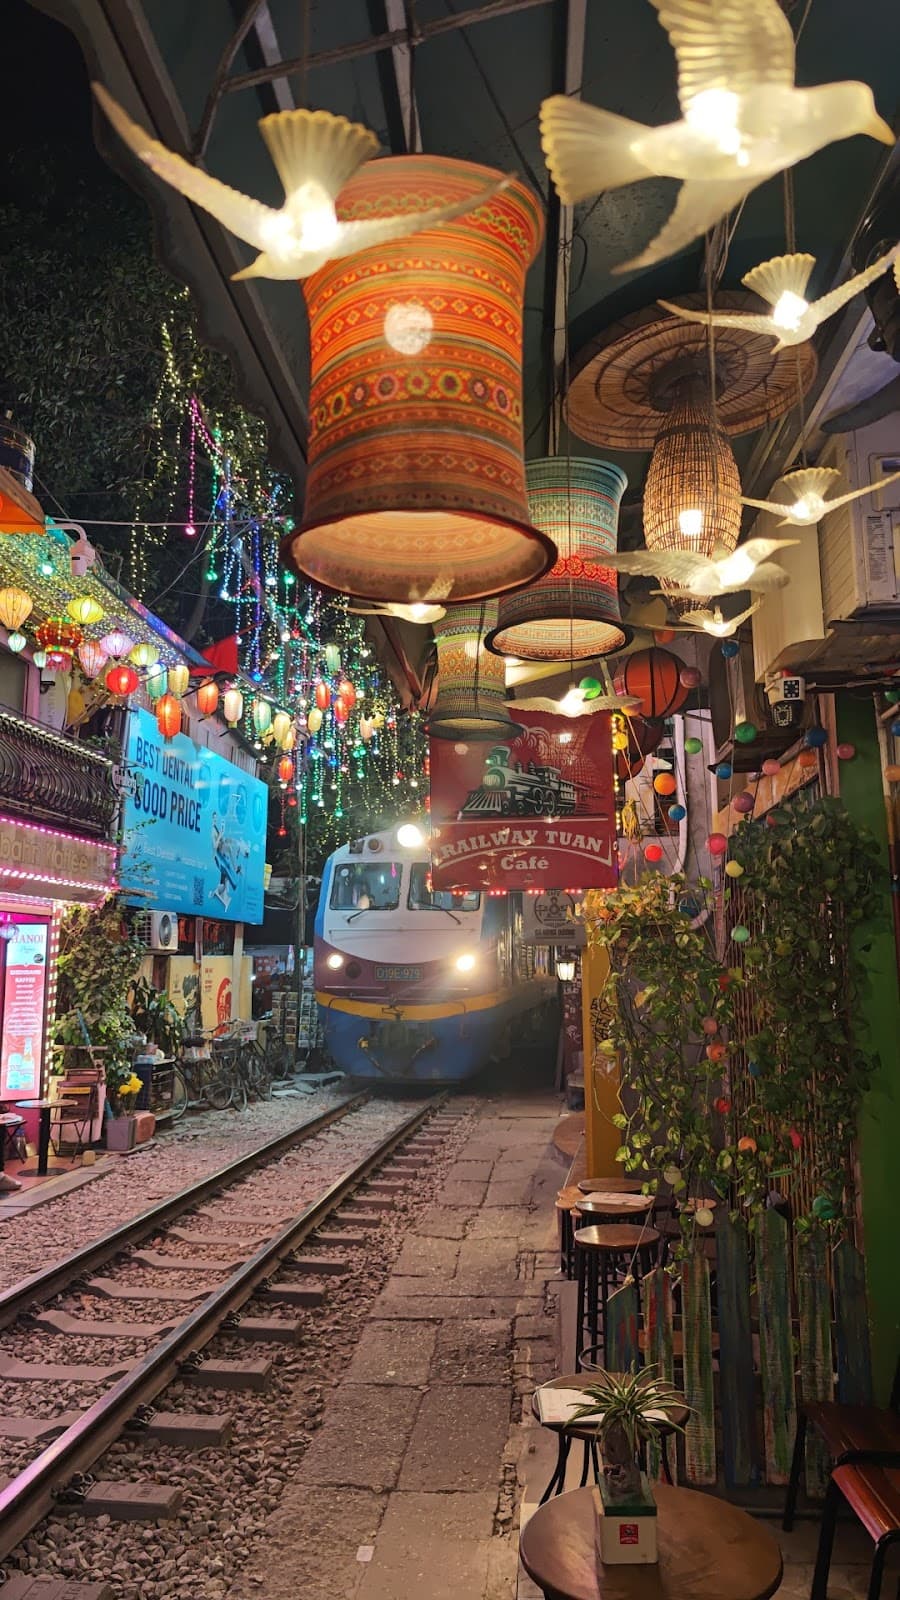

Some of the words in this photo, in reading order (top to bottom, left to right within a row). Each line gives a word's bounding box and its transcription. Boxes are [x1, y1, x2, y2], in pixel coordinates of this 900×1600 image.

[136, 736, 161, 772] BEST
[162, 752, 195, 790] DENTAL
[170, 791, 202, 832] PRICE
[439, 829, 539, 859] RAILWAY
[545, 831, 603, 853] TUAN
[500, 856, 549, 871] Café
